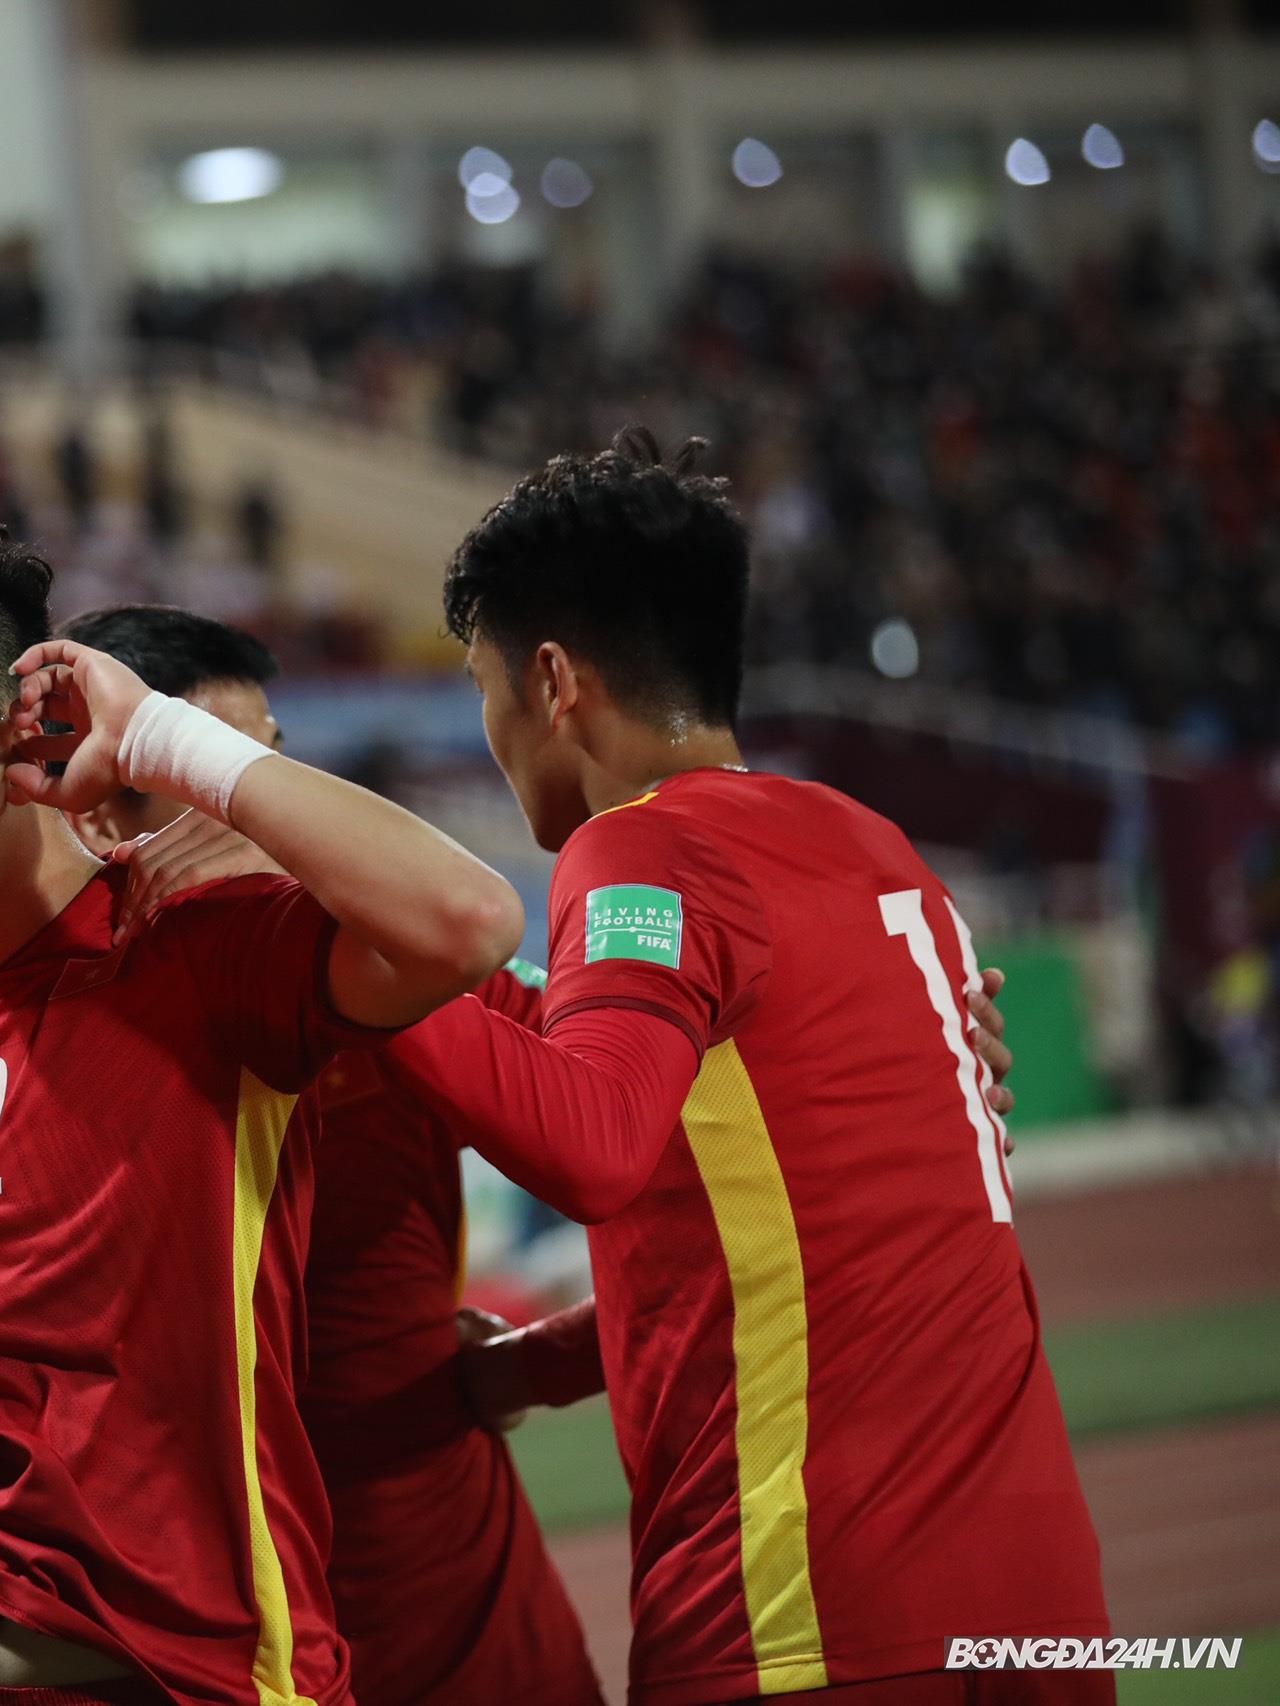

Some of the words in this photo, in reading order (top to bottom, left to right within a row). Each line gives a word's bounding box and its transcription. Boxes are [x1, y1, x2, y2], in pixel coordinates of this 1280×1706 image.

[594, 907, 673, 919] LIVING
[594, 916, 673, 928] FOOTBALL
[637, 935, 671, 950] FIFA
